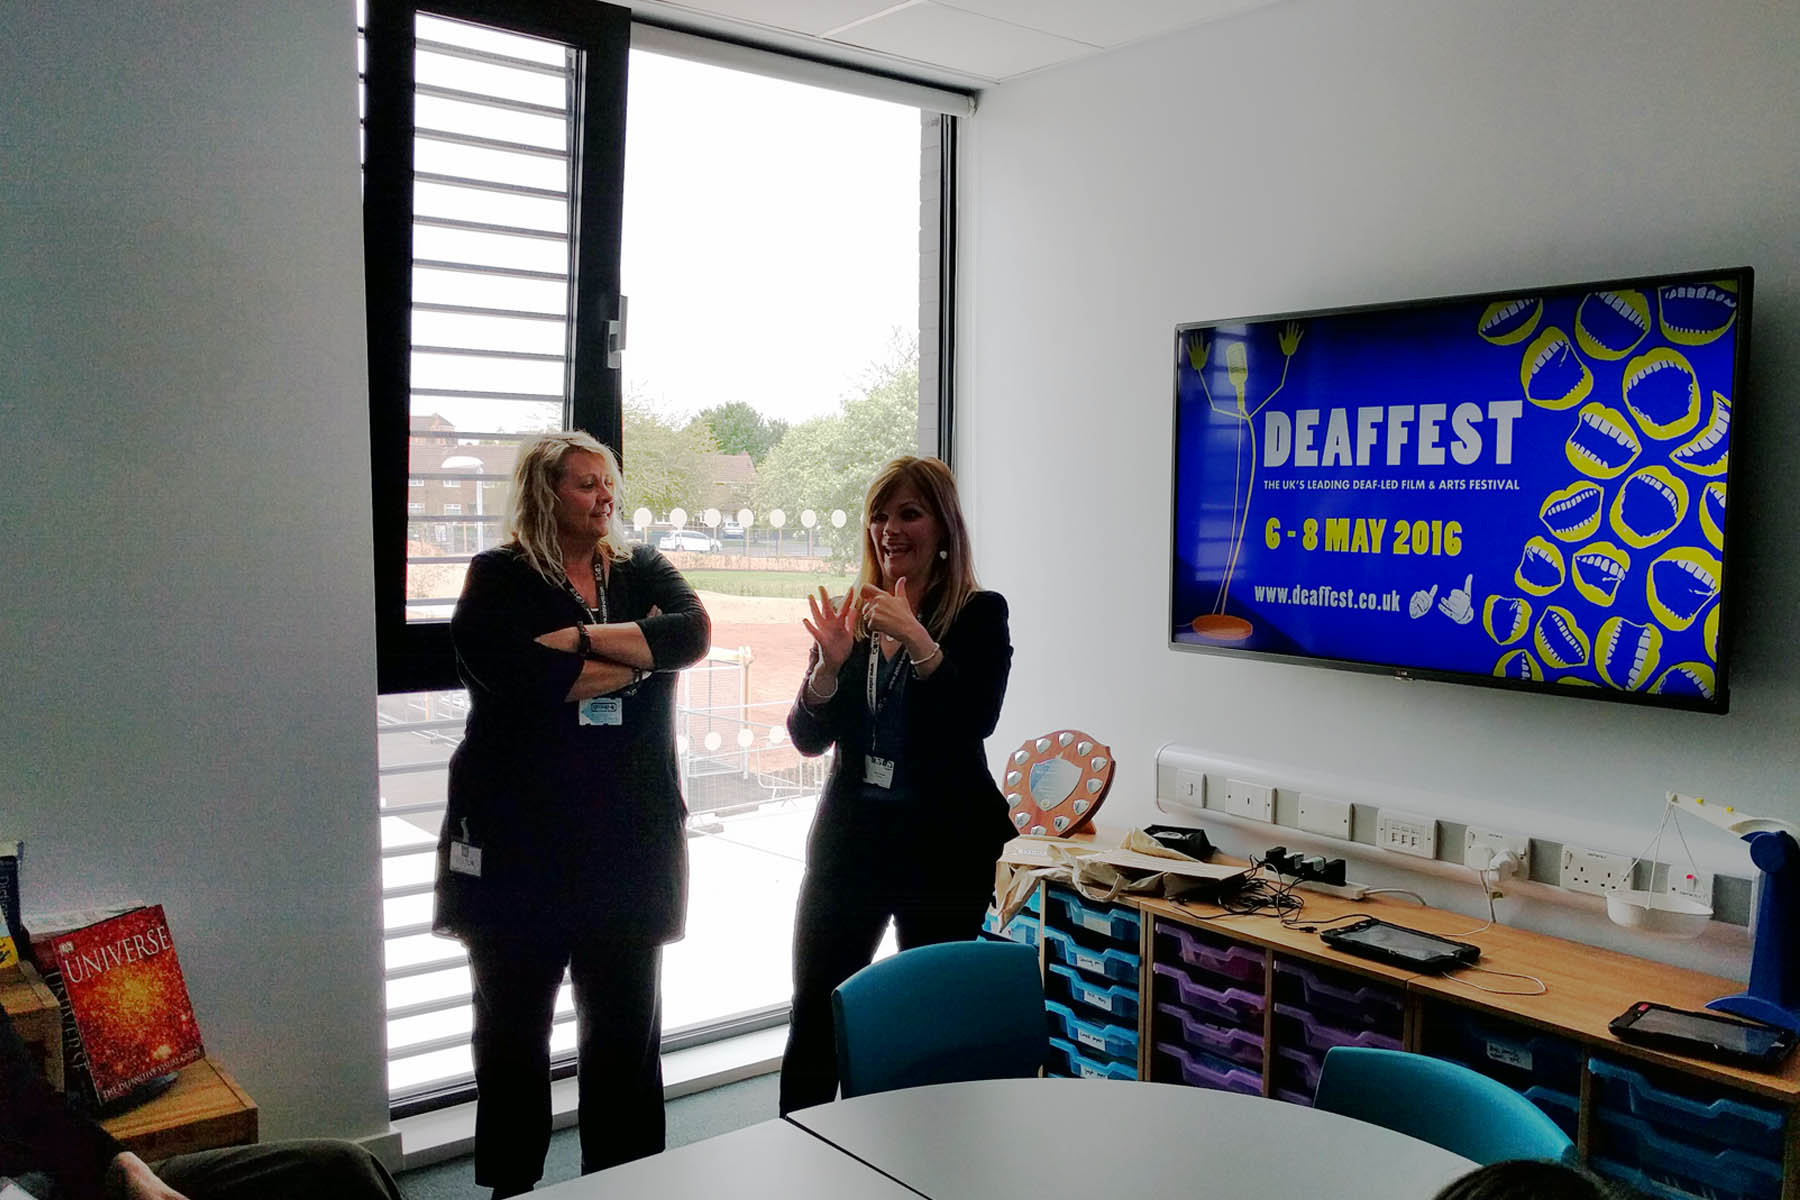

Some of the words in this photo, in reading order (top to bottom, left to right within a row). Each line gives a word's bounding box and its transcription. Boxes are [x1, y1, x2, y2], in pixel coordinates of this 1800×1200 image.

[1263, 400, 1523, 468] DEAFFEST
[1263, 480, 1280, 490] THE
[1282, 480, 1305, 490] UK'S
[1307, 480, 1350, 490] LEADING
[1353, 480, 1398, 490] DEAF-LED
[1401, 480, 1425, 490] FILM
[1428, 480, 1435, 490] &
[1438, 480, 1466, 490] ARTS
[1469, 479, 1520, 490] FESTIVAL
[1265, 517, 1280, 549] 6
[1302, 518, 1318, 551] 8
[1325, 518, 1387, 553] MAY
[1393, 520, 1462, 556] 2016
[1254, 584, 1400, 612] www.deaffest.co.uk
[65, 925, 171, 984] UNIVERSE
